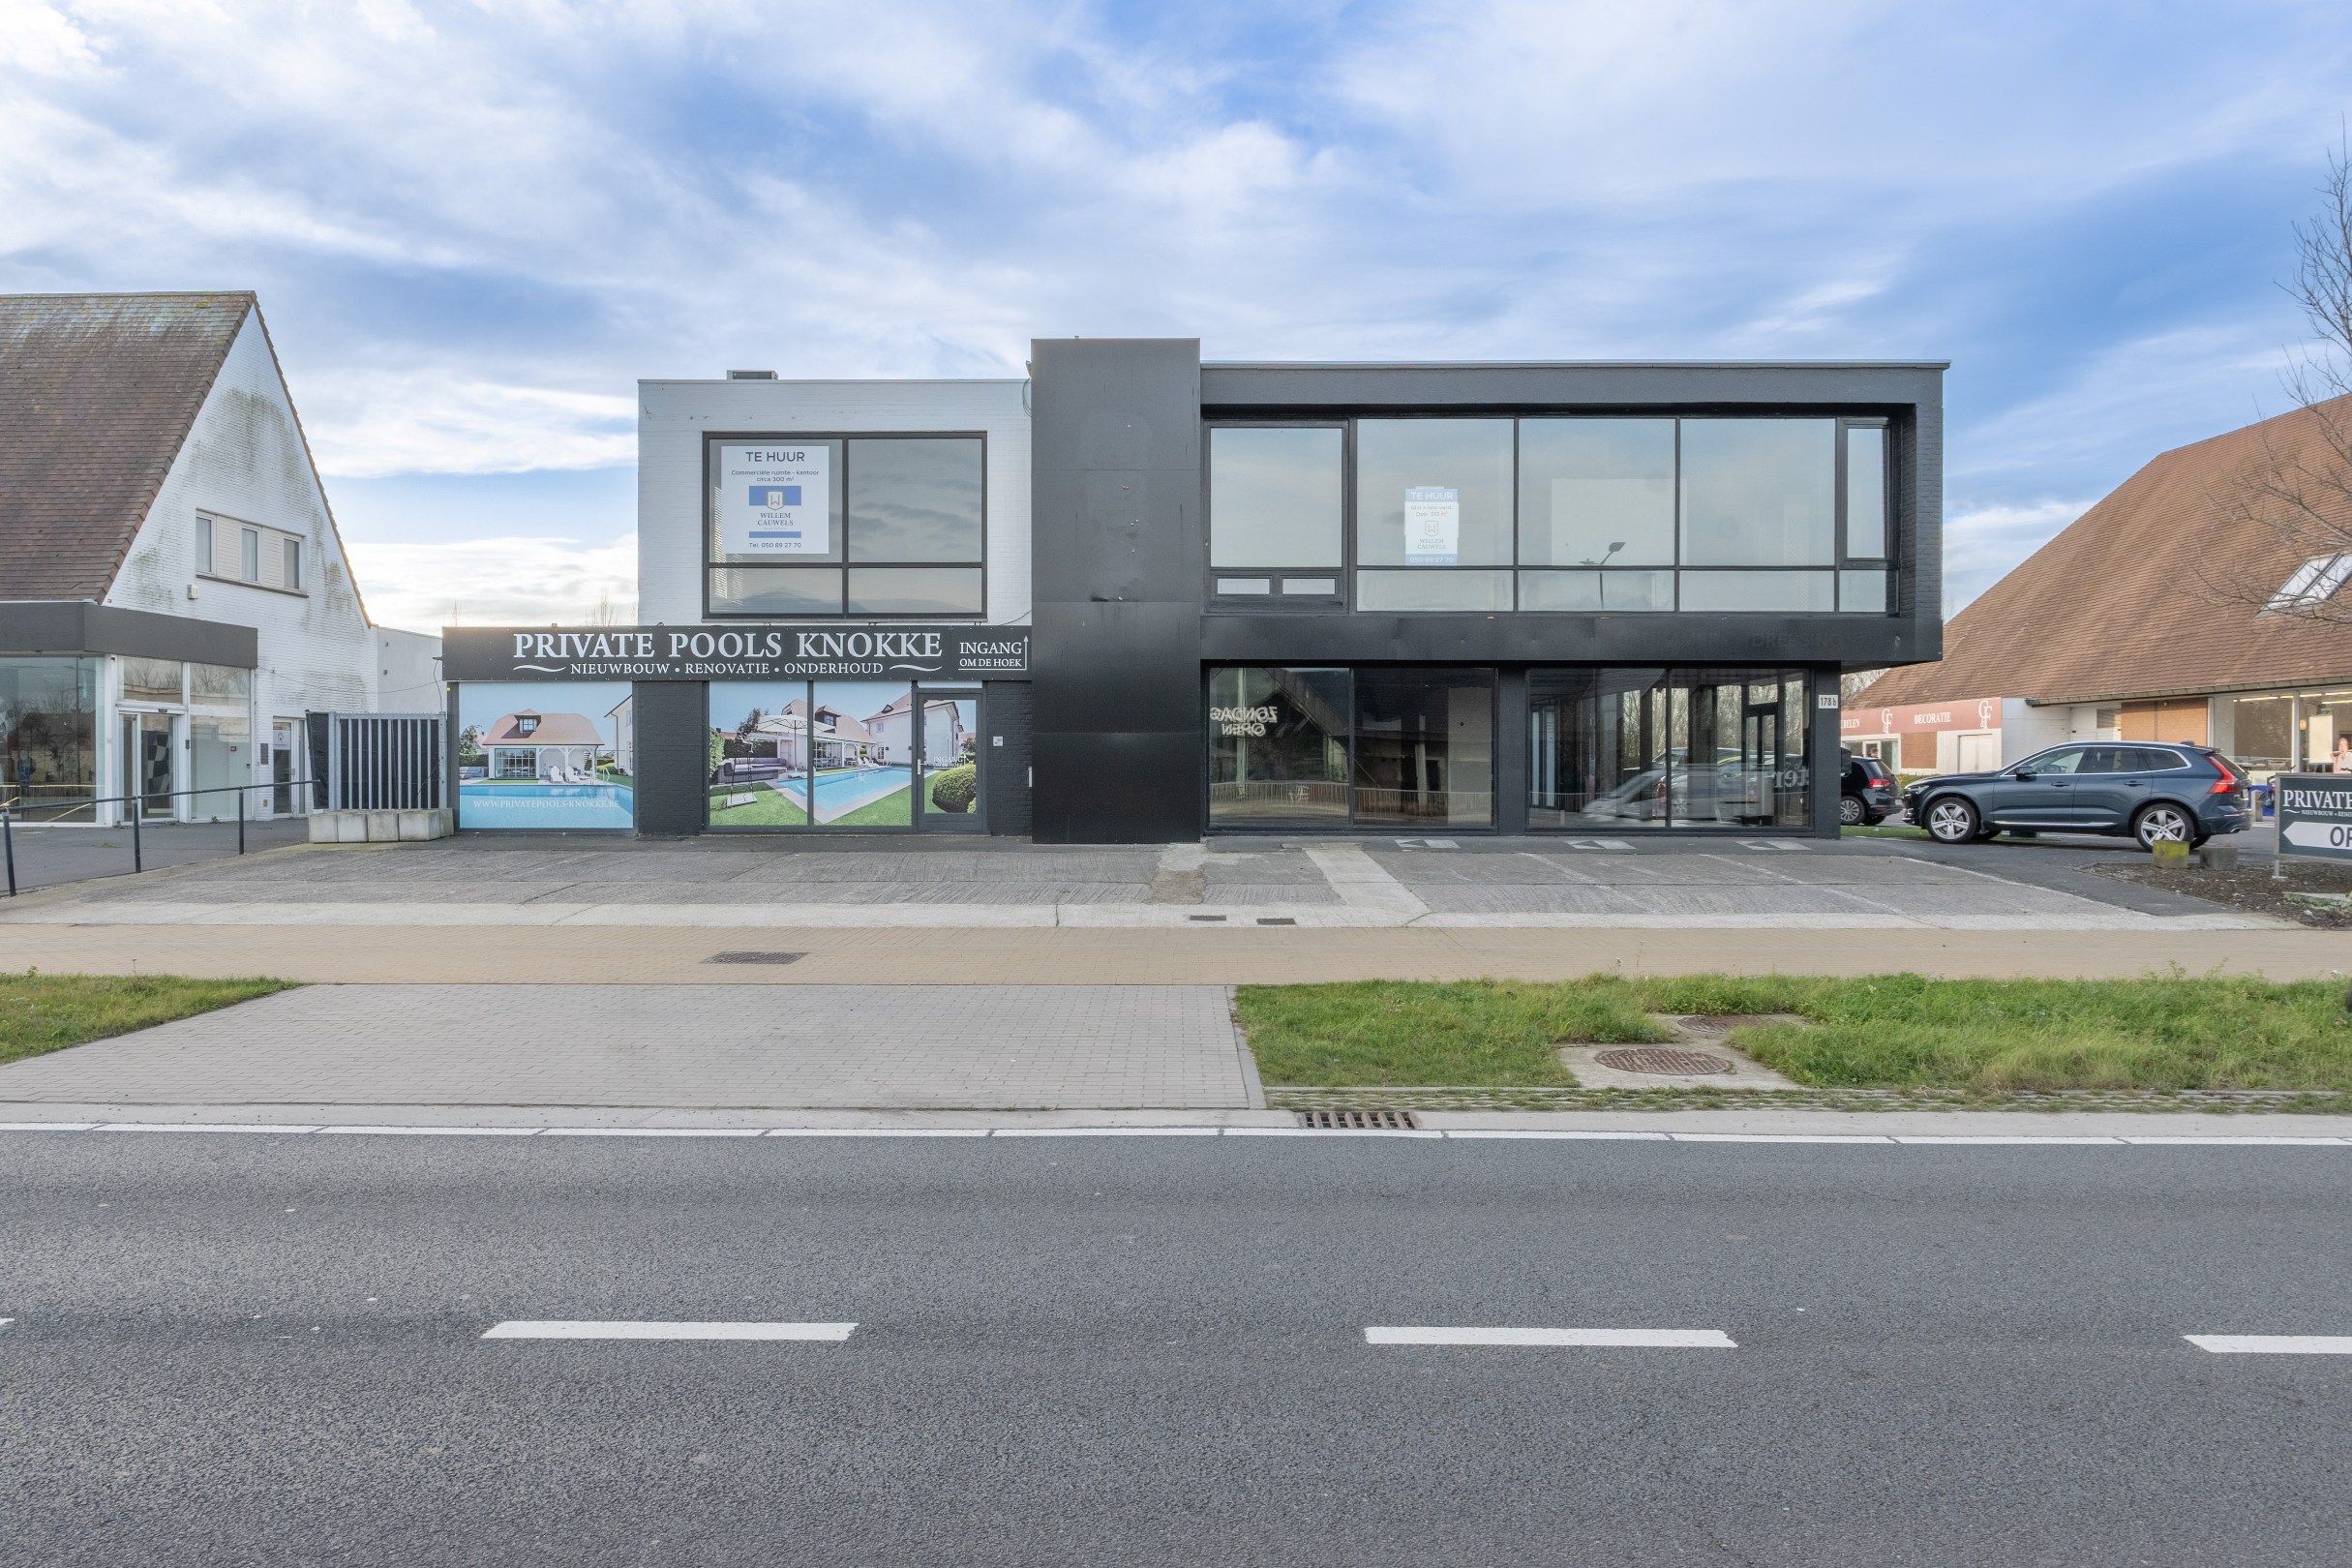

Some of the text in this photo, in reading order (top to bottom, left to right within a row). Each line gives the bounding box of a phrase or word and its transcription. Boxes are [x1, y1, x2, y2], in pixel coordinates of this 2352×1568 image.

[745, 451, 805, 463] TE HUUR
[1410, 492, 1454, 500] TE HUUR
[513, 631, 943, 659] PRIVATE POOLS KNOKKE
[959, 641, 1022, 654] INGANG
[570, 662, 884, 675] NIEUWBOUW RENOVATIE ONDERHOUD
[959, 658, 1022, 667] OM DE HOEK
[1914, 711, 1951, 725] DECORATIE
[473, 799, 619, 808] WWW.PRIVATEPOOLS-KNOKKE.BE
